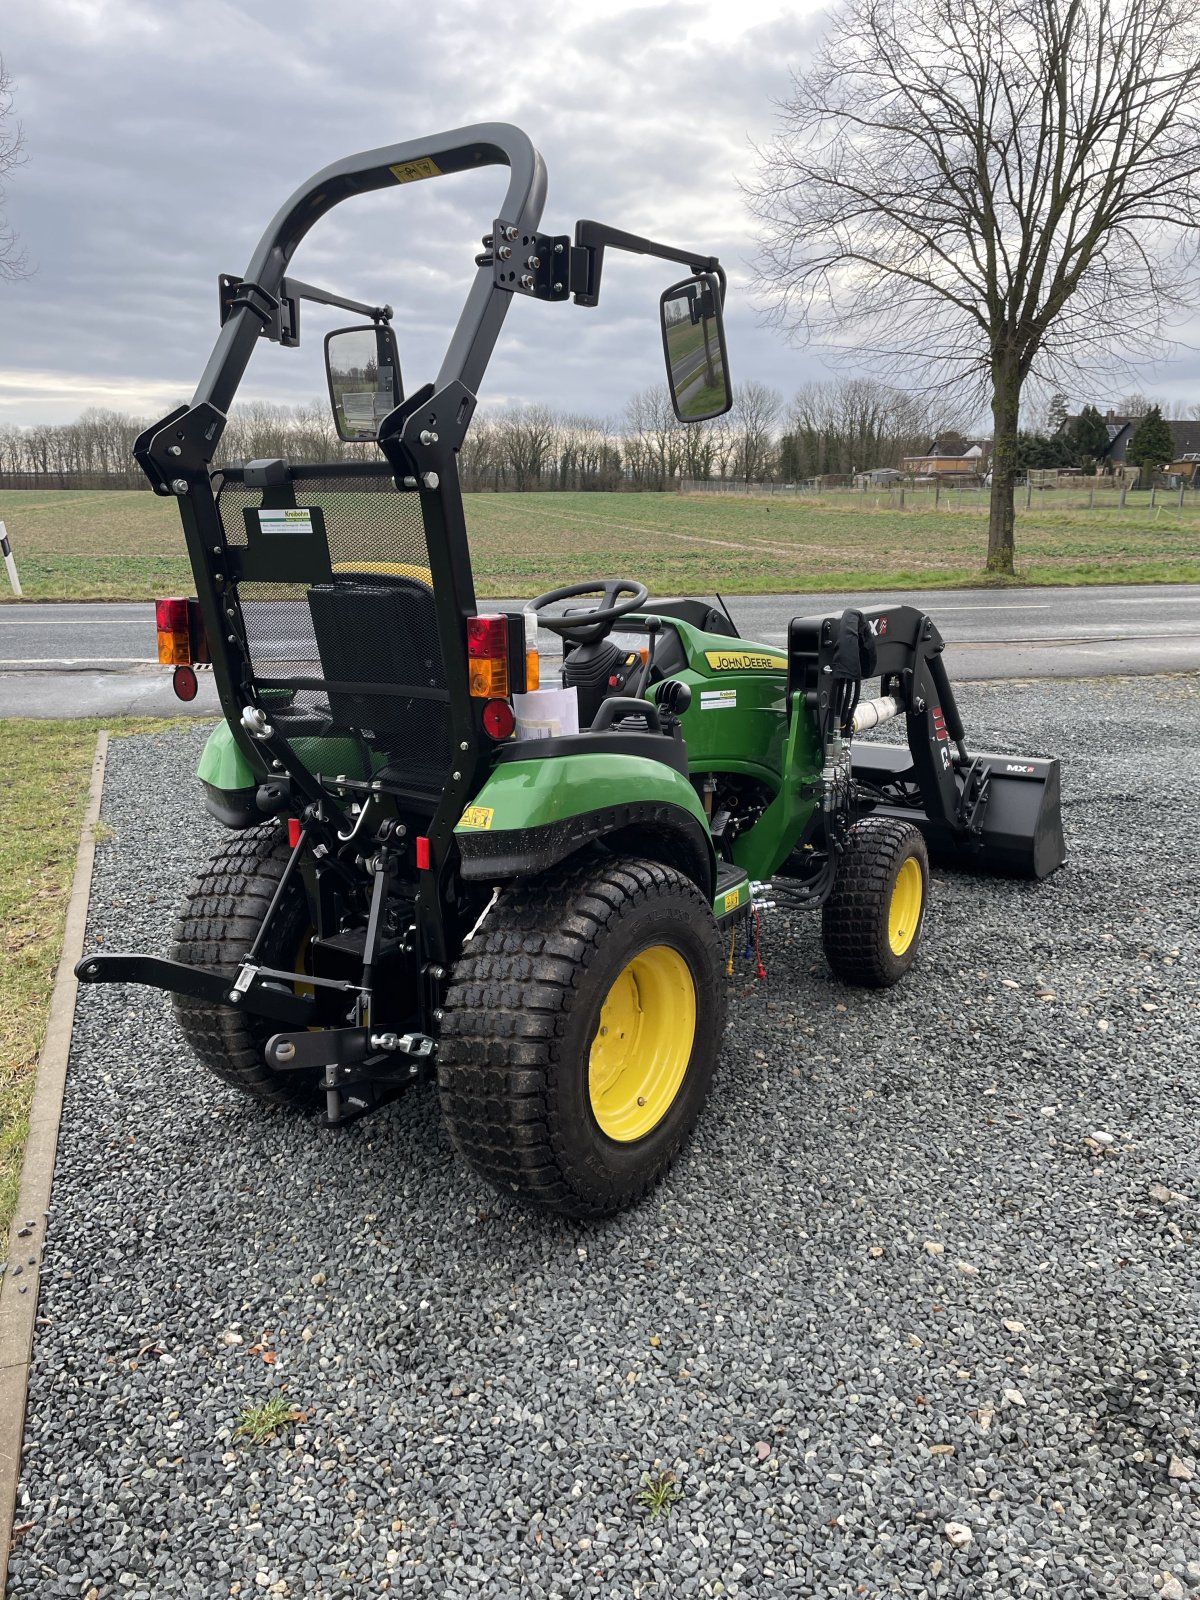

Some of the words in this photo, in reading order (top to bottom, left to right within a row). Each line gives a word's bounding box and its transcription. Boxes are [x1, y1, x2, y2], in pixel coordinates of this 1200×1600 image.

[868, 618, 880, 636] X
[717, 656, 742, 668] JOHN
[743, 656, 773, 668] DEERE
